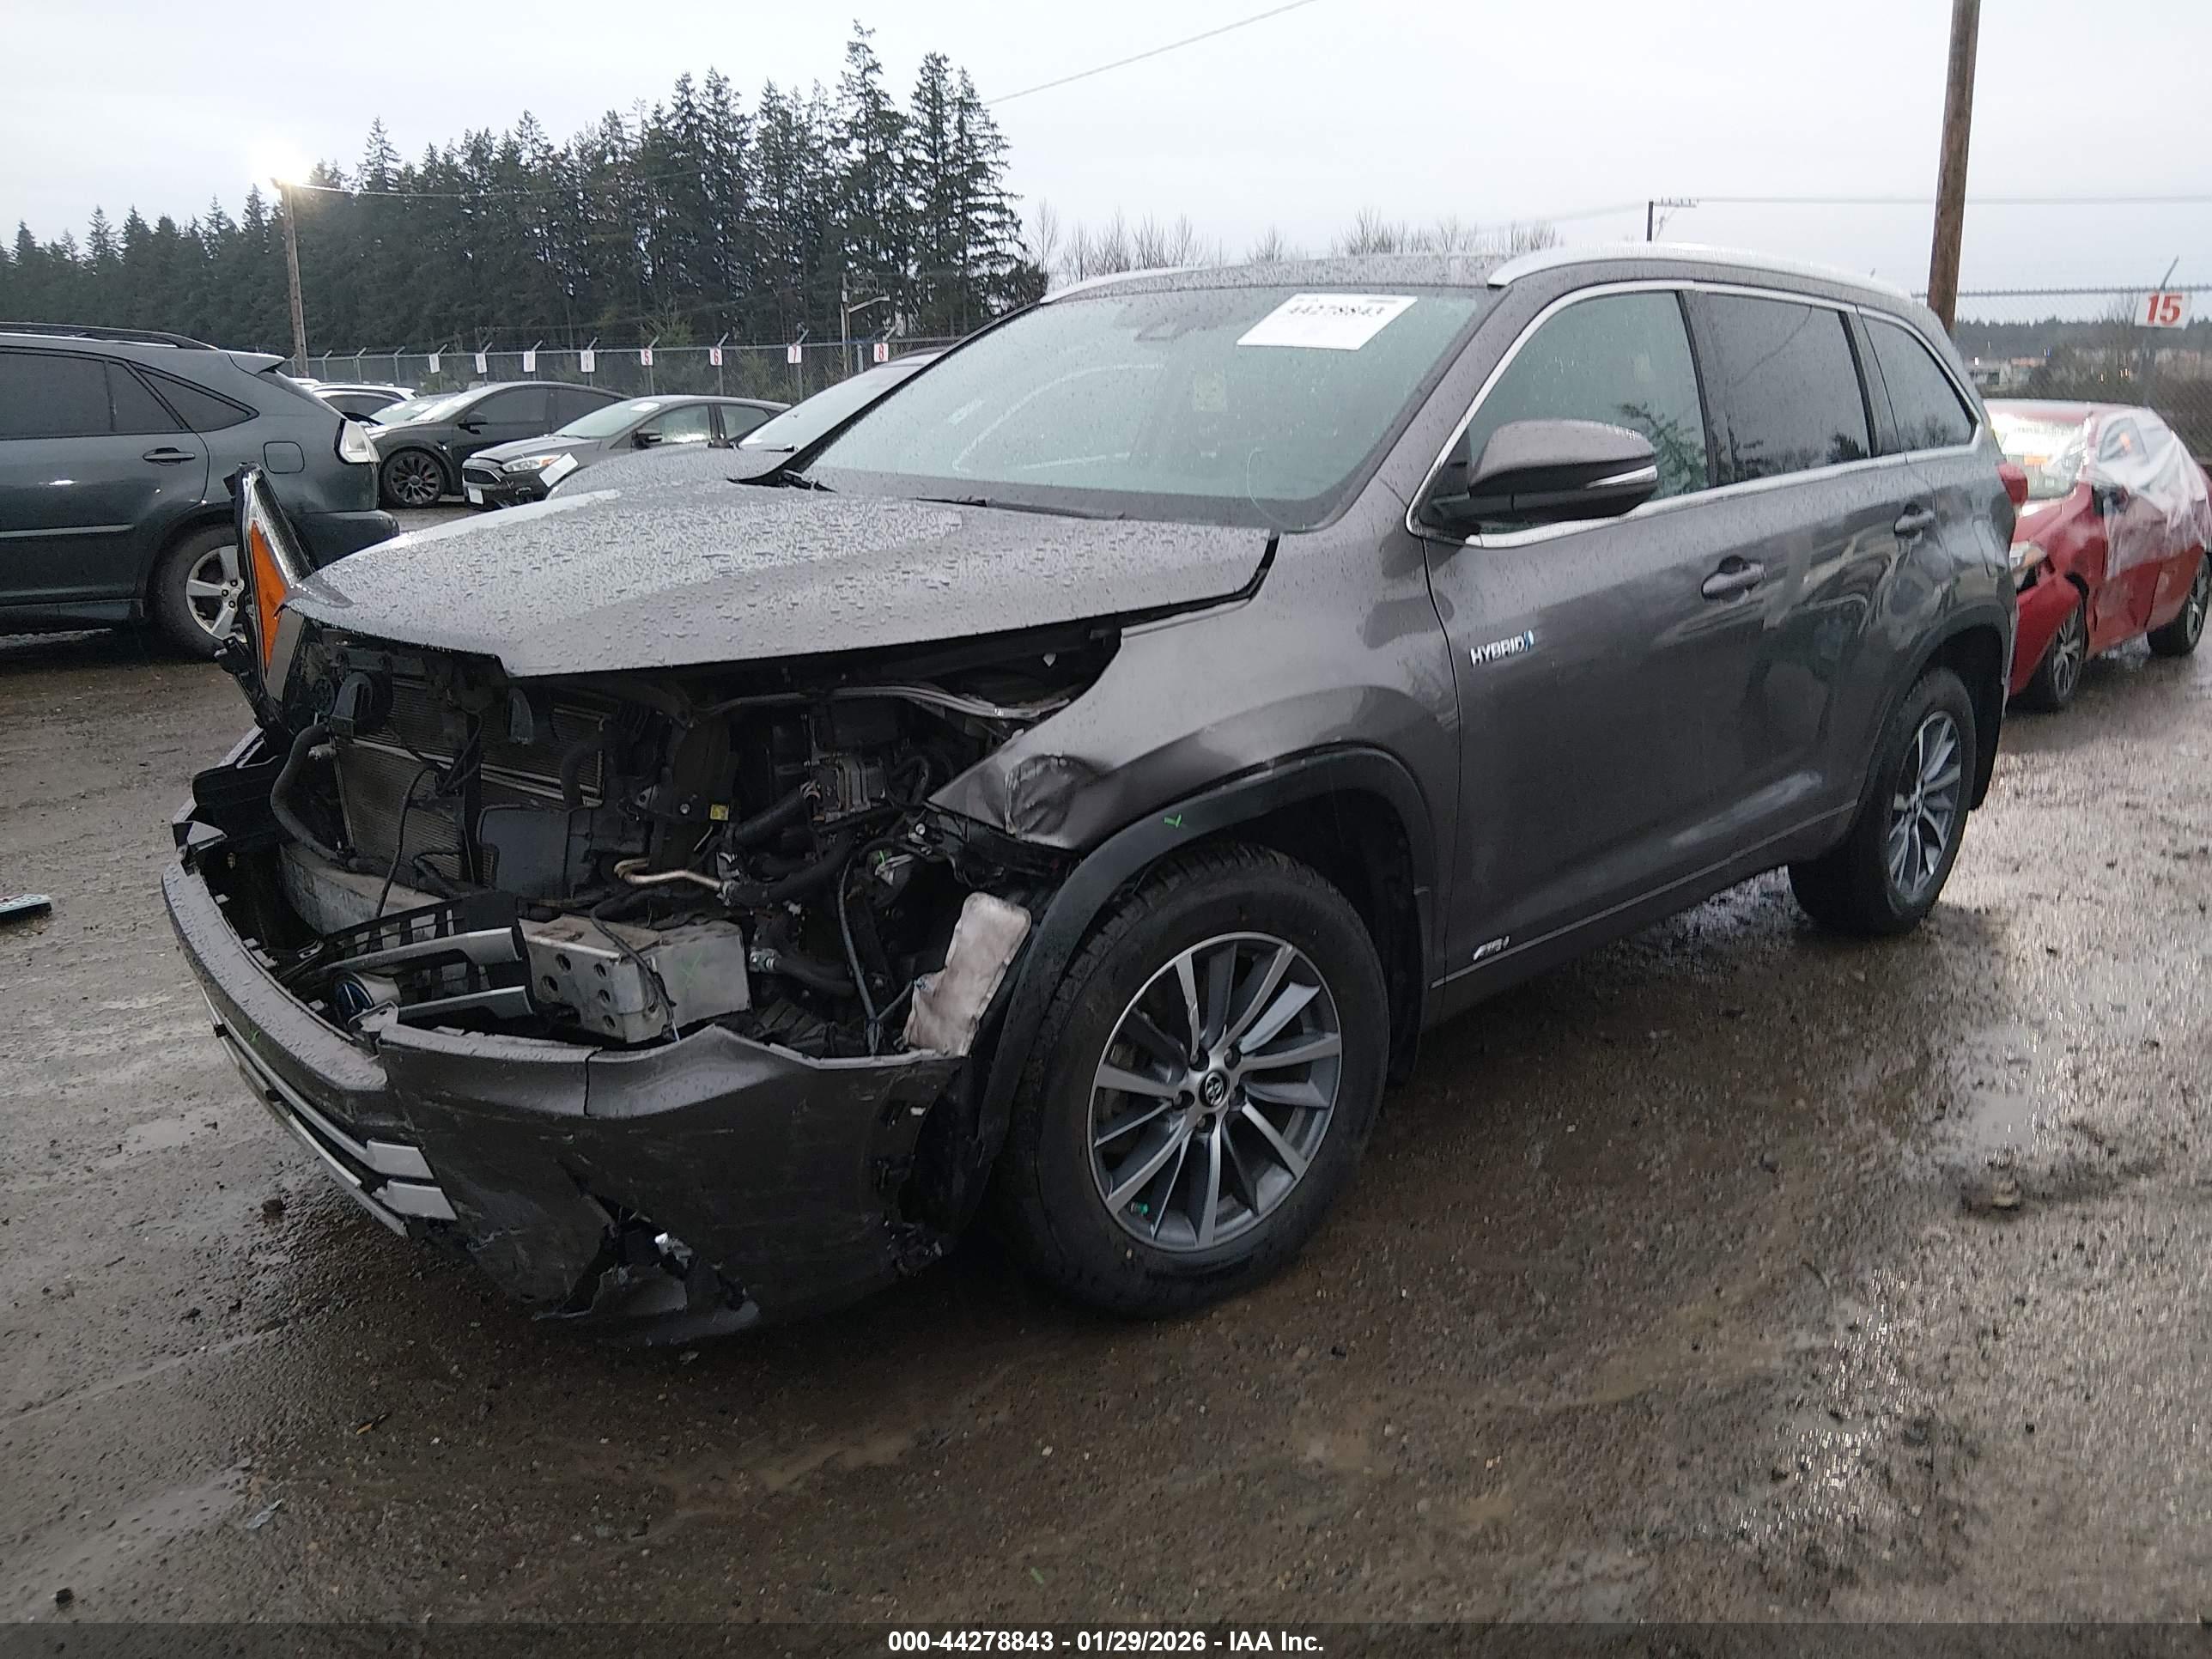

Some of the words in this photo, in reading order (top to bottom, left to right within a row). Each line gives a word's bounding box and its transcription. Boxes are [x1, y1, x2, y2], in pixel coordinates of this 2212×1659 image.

[2148, 293, 2183, 326] 15
[878, 343, 884, 362] 8
[1469, 635, 1524, 667] HYBRID
